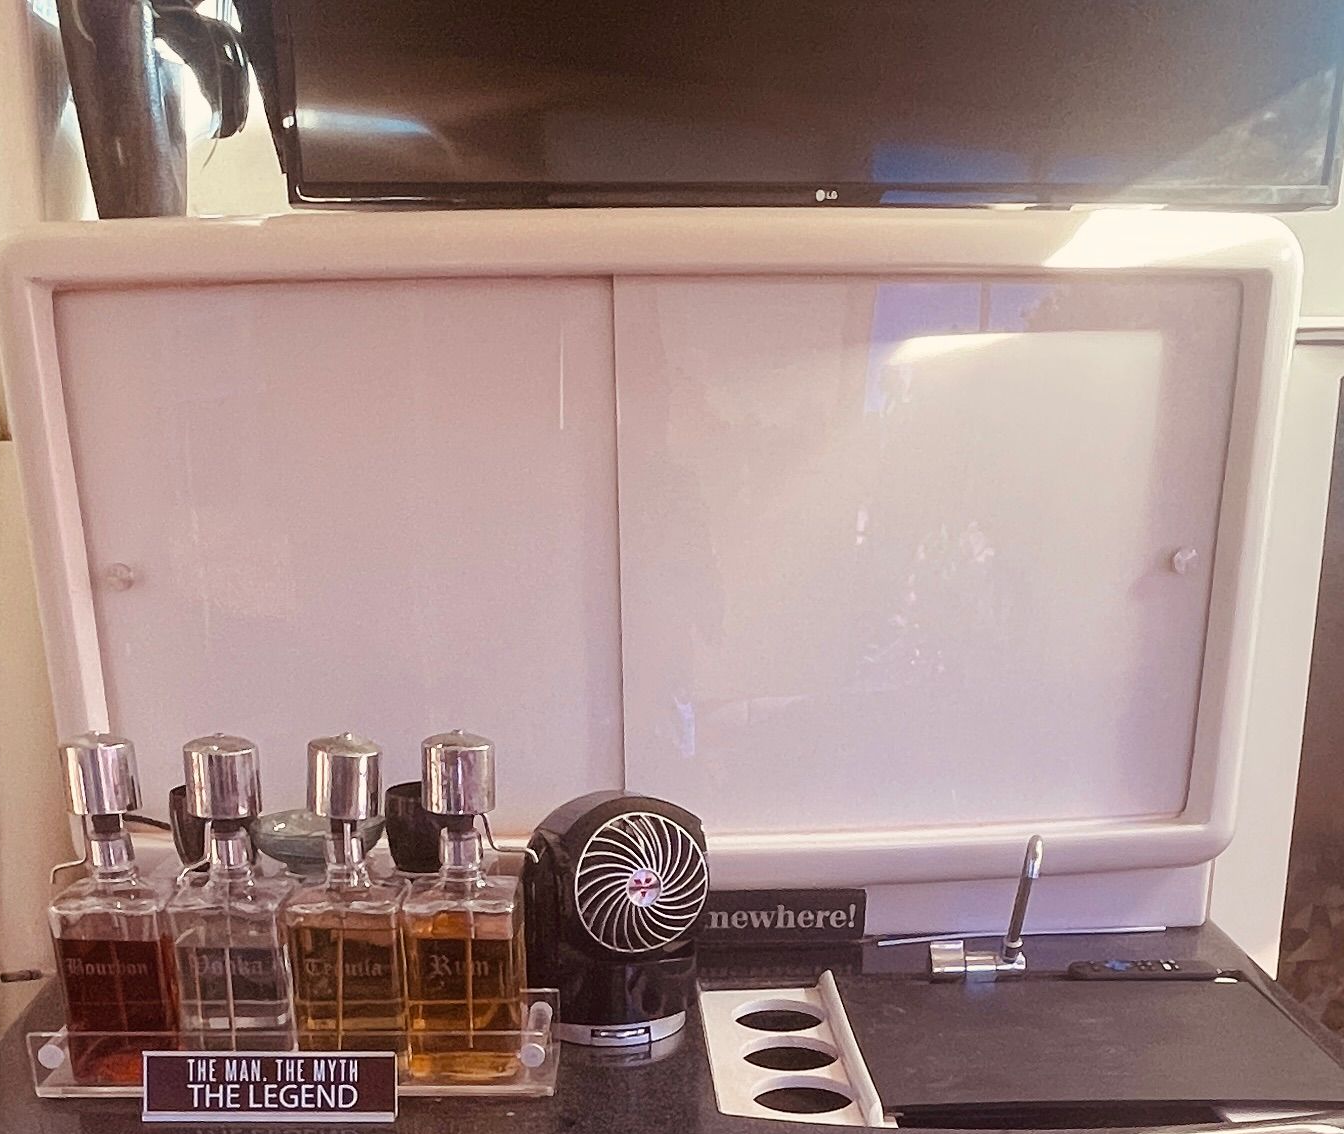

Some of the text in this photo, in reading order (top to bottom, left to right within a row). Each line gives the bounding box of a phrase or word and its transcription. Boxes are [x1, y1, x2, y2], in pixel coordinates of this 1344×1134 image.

[704, 903, 857, 929] mewhere!
[65, 956, 150, 976] Bourbon
[303, 957, 385, 977] Teuila
[187, 1058, 217, 1082] THE
[275, 1059, 305, 1082] THE
[313, 1059, 358, 1082] MYTH
[187, 1084, 358, 1109] THE LEGEND
